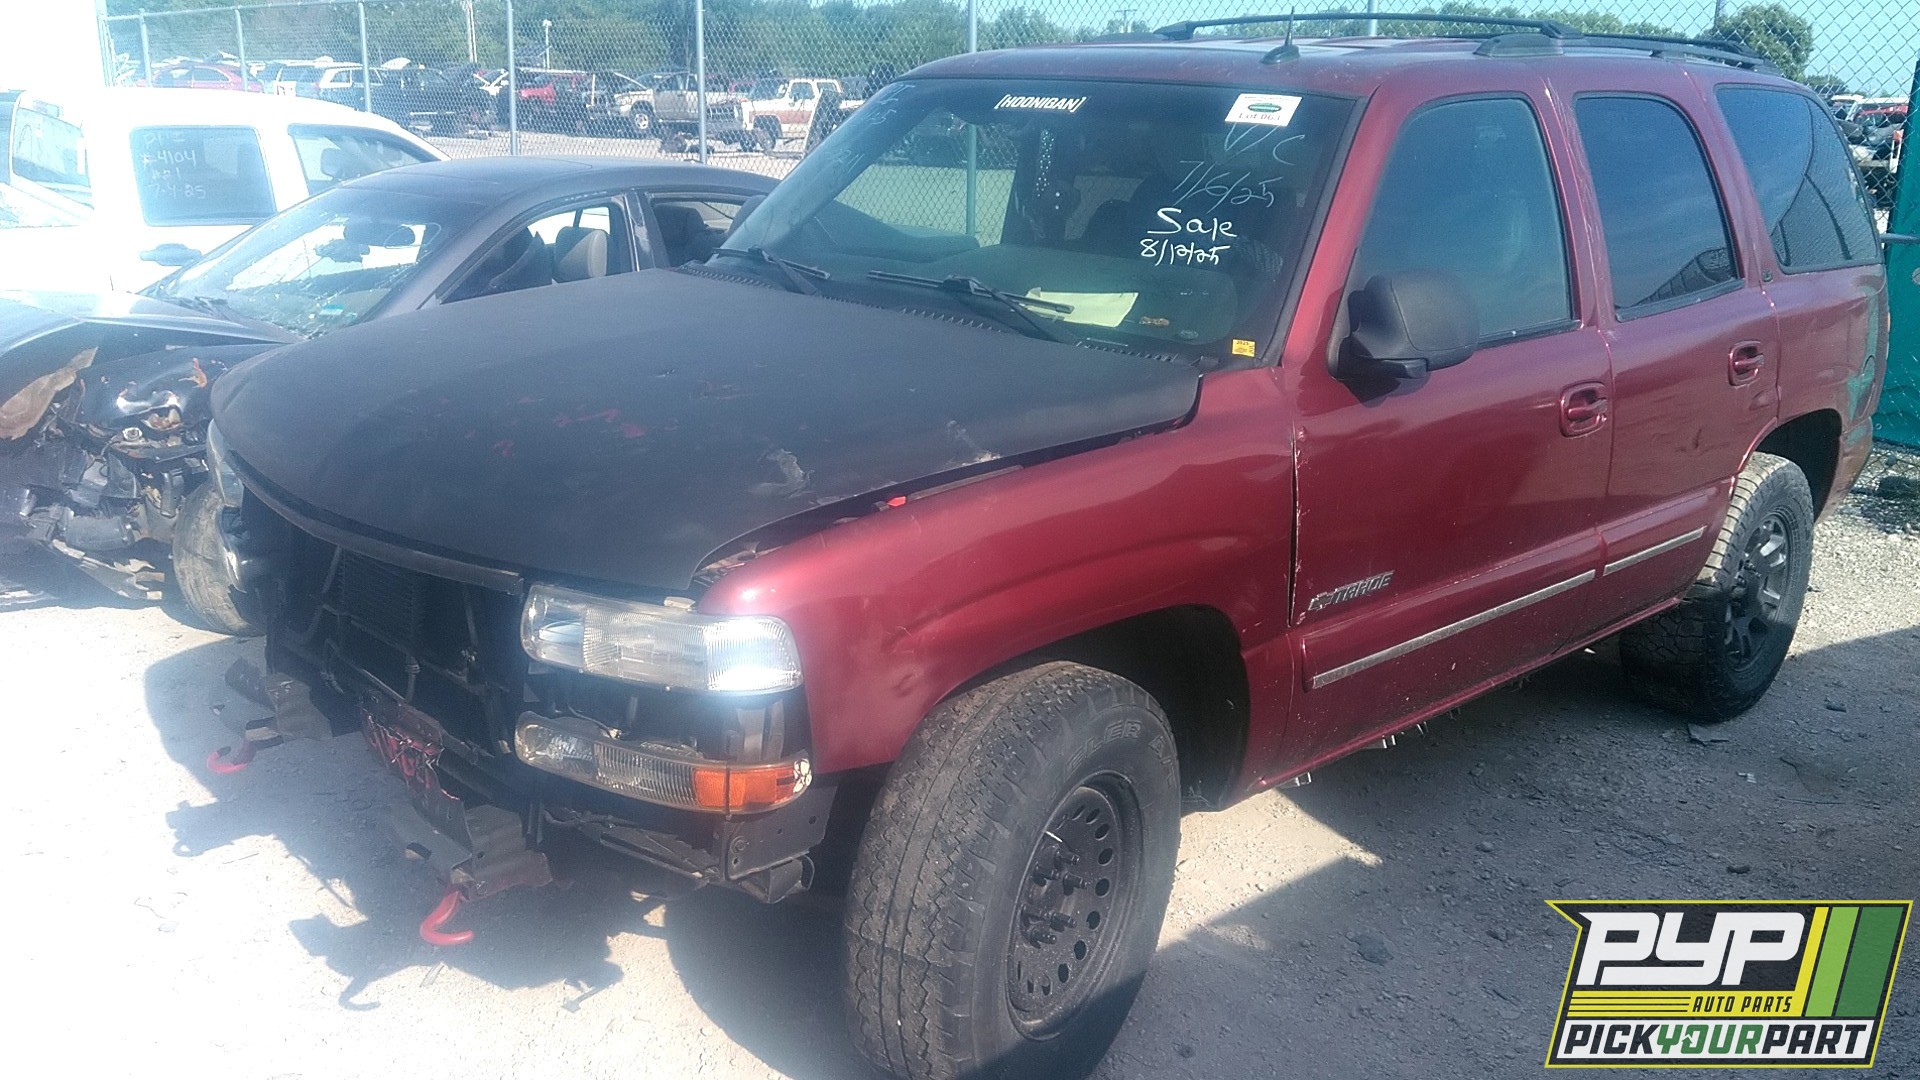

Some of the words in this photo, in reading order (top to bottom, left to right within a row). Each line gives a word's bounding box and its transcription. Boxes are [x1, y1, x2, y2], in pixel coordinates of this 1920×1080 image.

[1172, 160, 1284, 214] 7/6/25
[1146, 207, 1238, 242] Sale
[1139, 239, 1231, 267] 8/12/25
